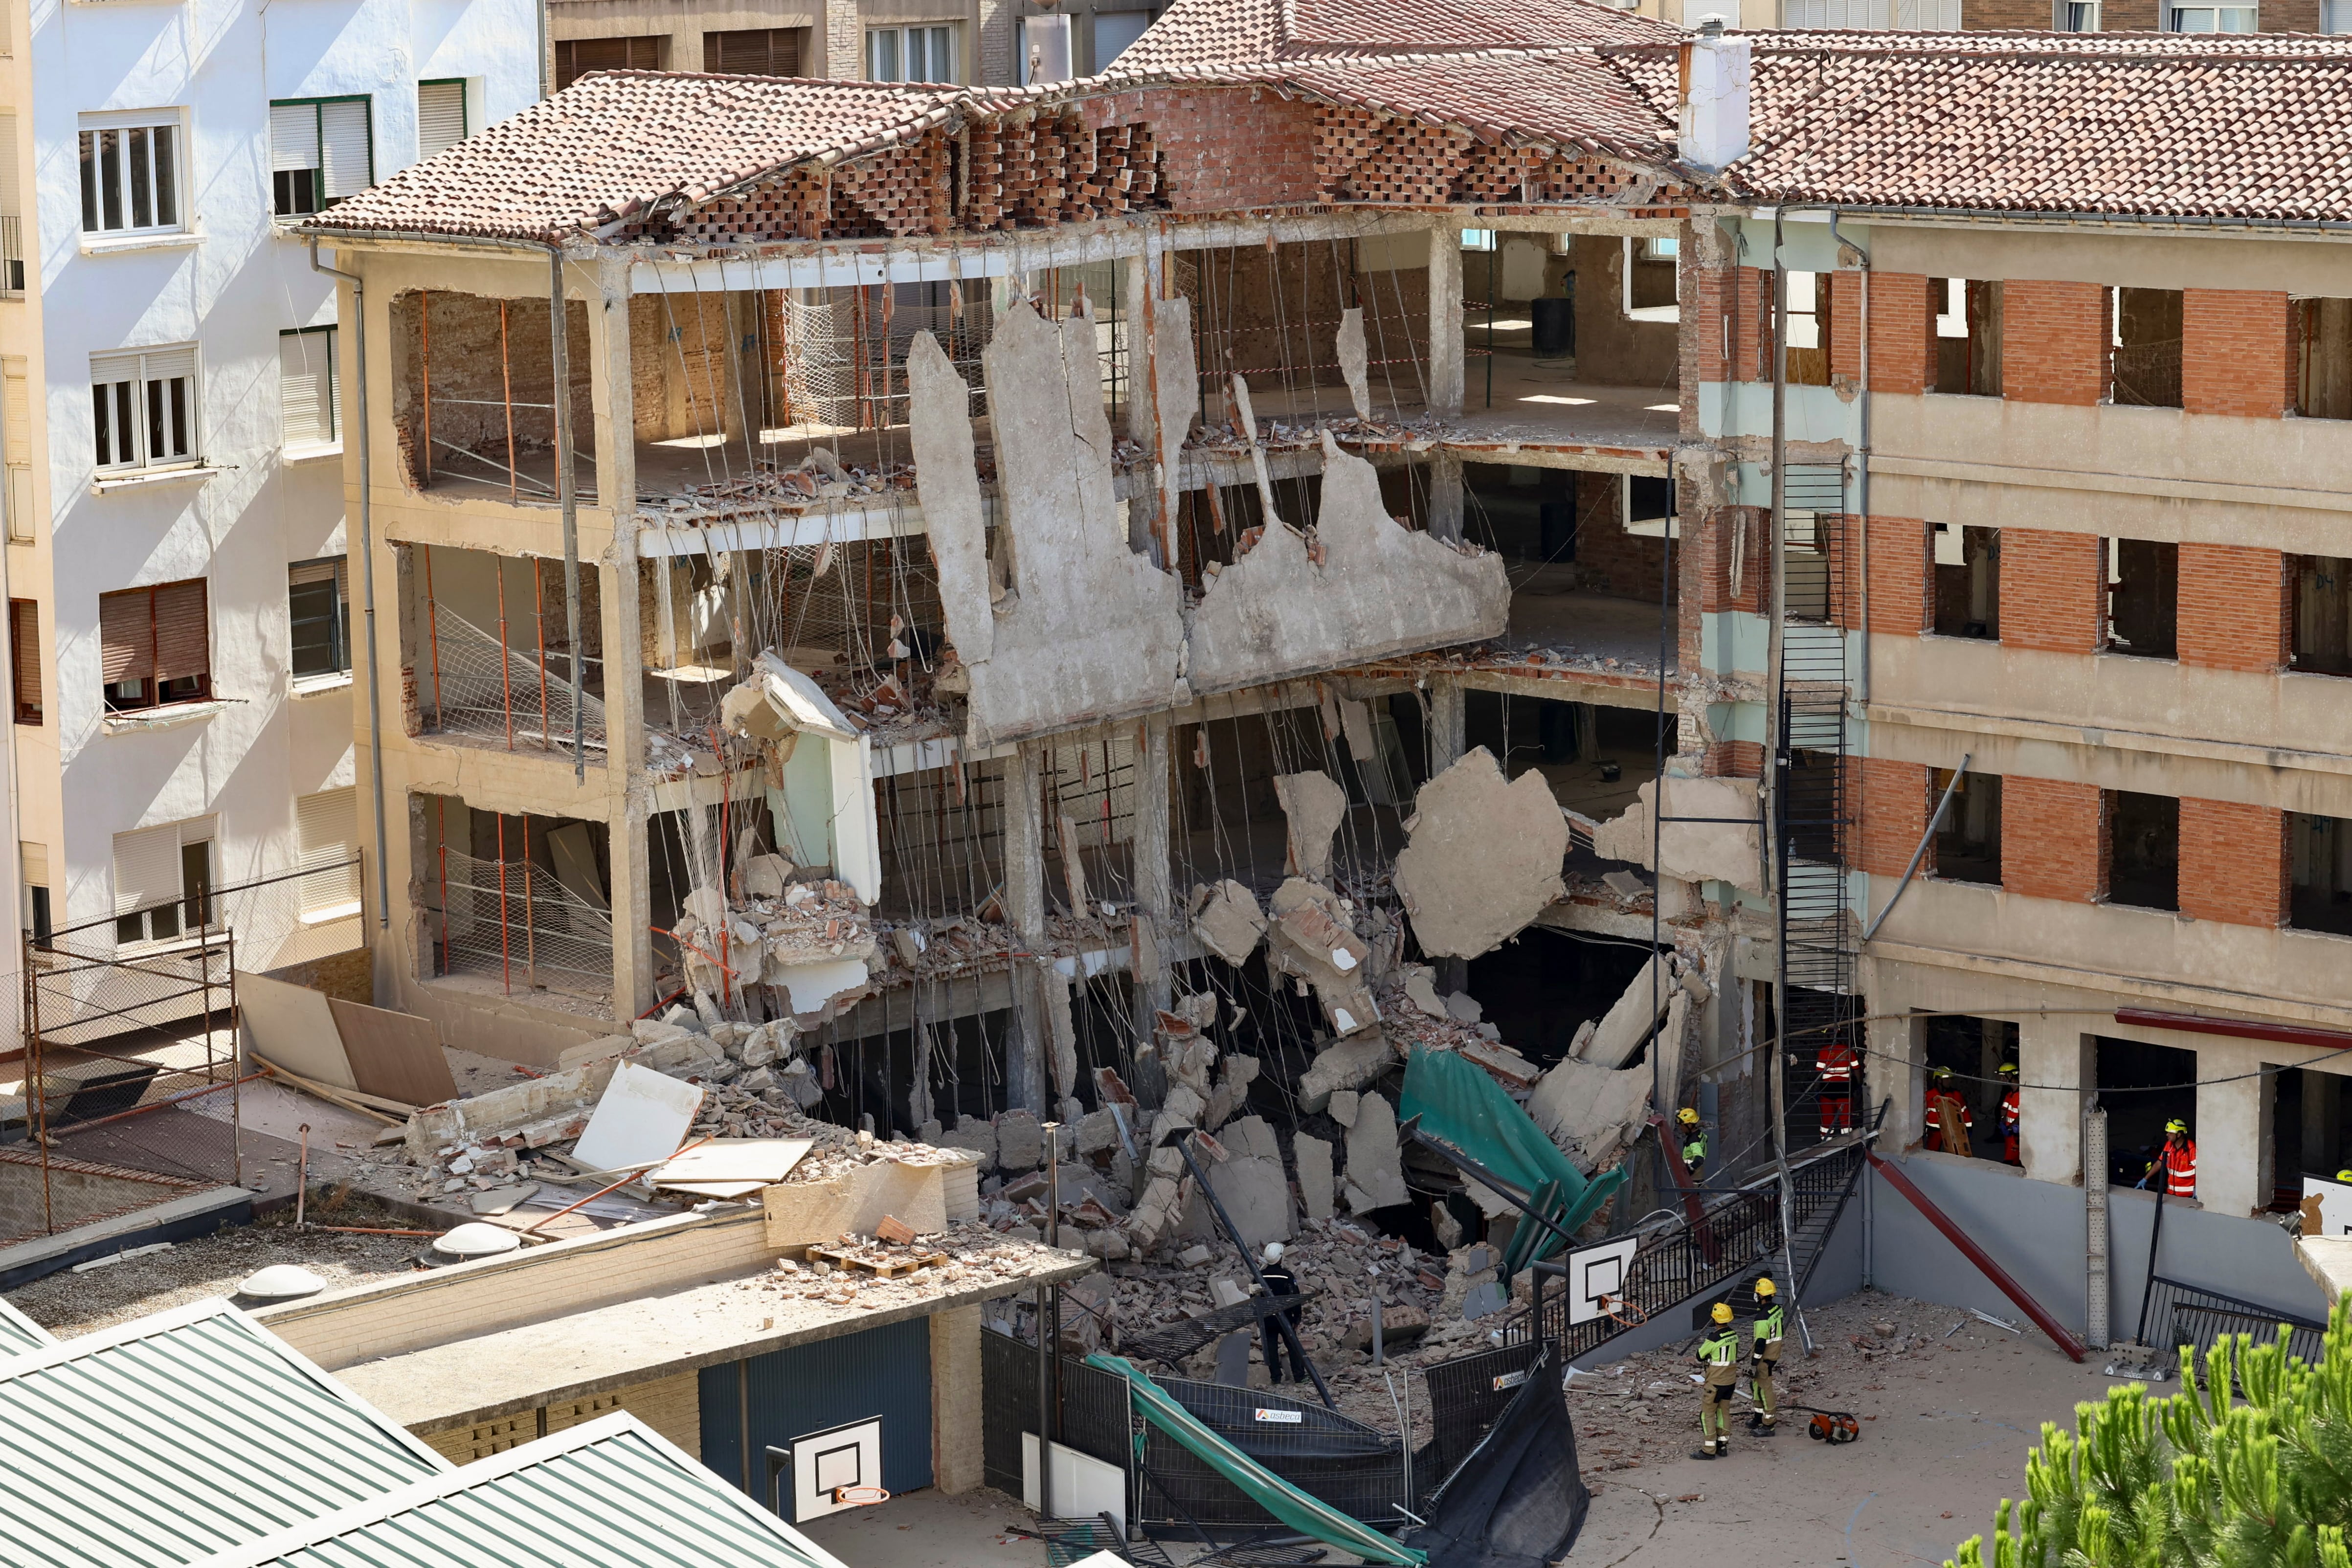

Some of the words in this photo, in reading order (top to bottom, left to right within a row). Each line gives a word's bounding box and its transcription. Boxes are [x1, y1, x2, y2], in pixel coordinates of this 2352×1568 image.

[668, 326, 682, 343] A8
[741, 334, 757, 353] A7
[2316, 572, 2333, 595] D4
[1504, 1373, 1524, 1386] asbeca
[1270, 1411, 1300, 1420] asbeca
